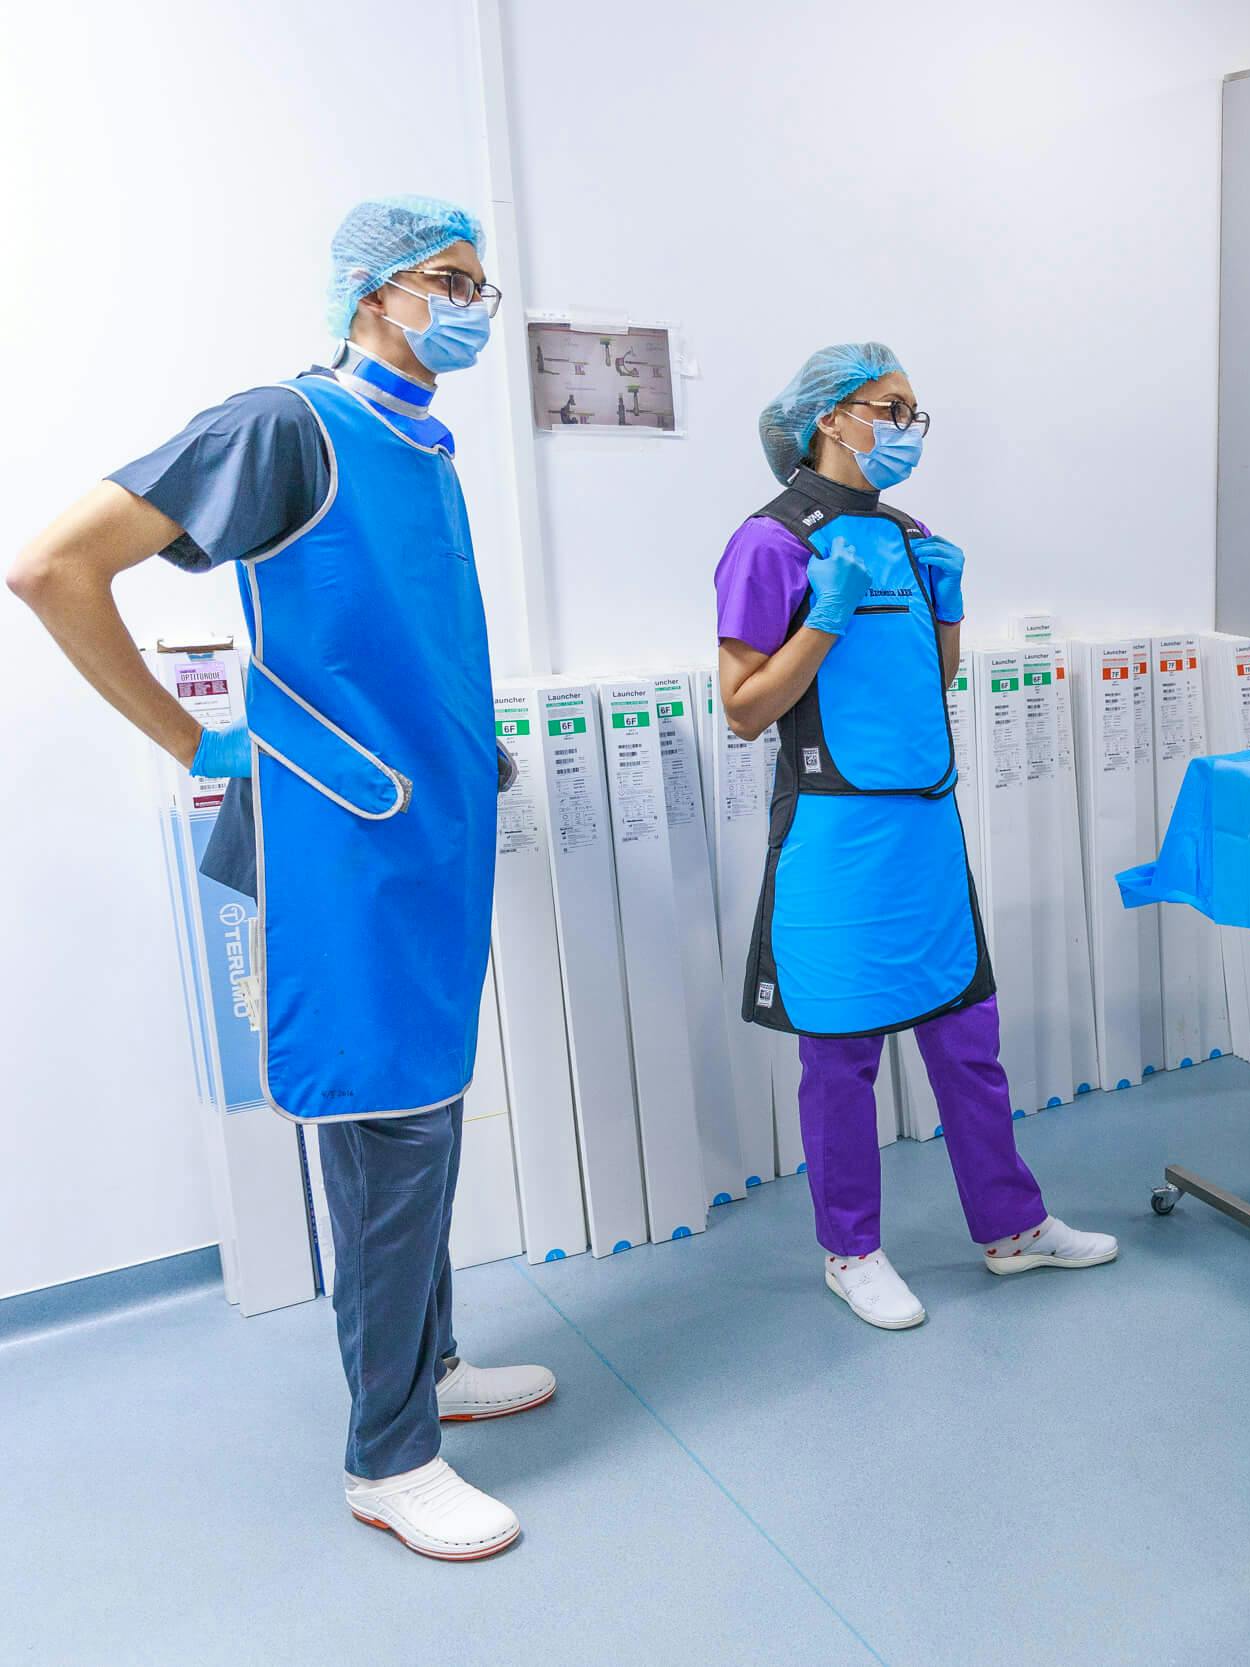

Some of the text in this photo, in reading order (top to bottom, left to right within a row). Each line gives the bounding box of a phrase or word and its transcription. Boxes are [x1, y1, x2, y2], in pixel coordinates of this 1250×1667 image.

[547, 692, 581, 701] Launcher
[612, 689, 646, 698] Launcher
[495, 696, 525, 704] auncher
[660, 706, 671, 714] 6F
[561, 721, 573, 730] 6F
[625, 717, 637, 726] 6F
[504, 724, 516, 734] 6F
[224, 926, 249, 1018] TERUMO
